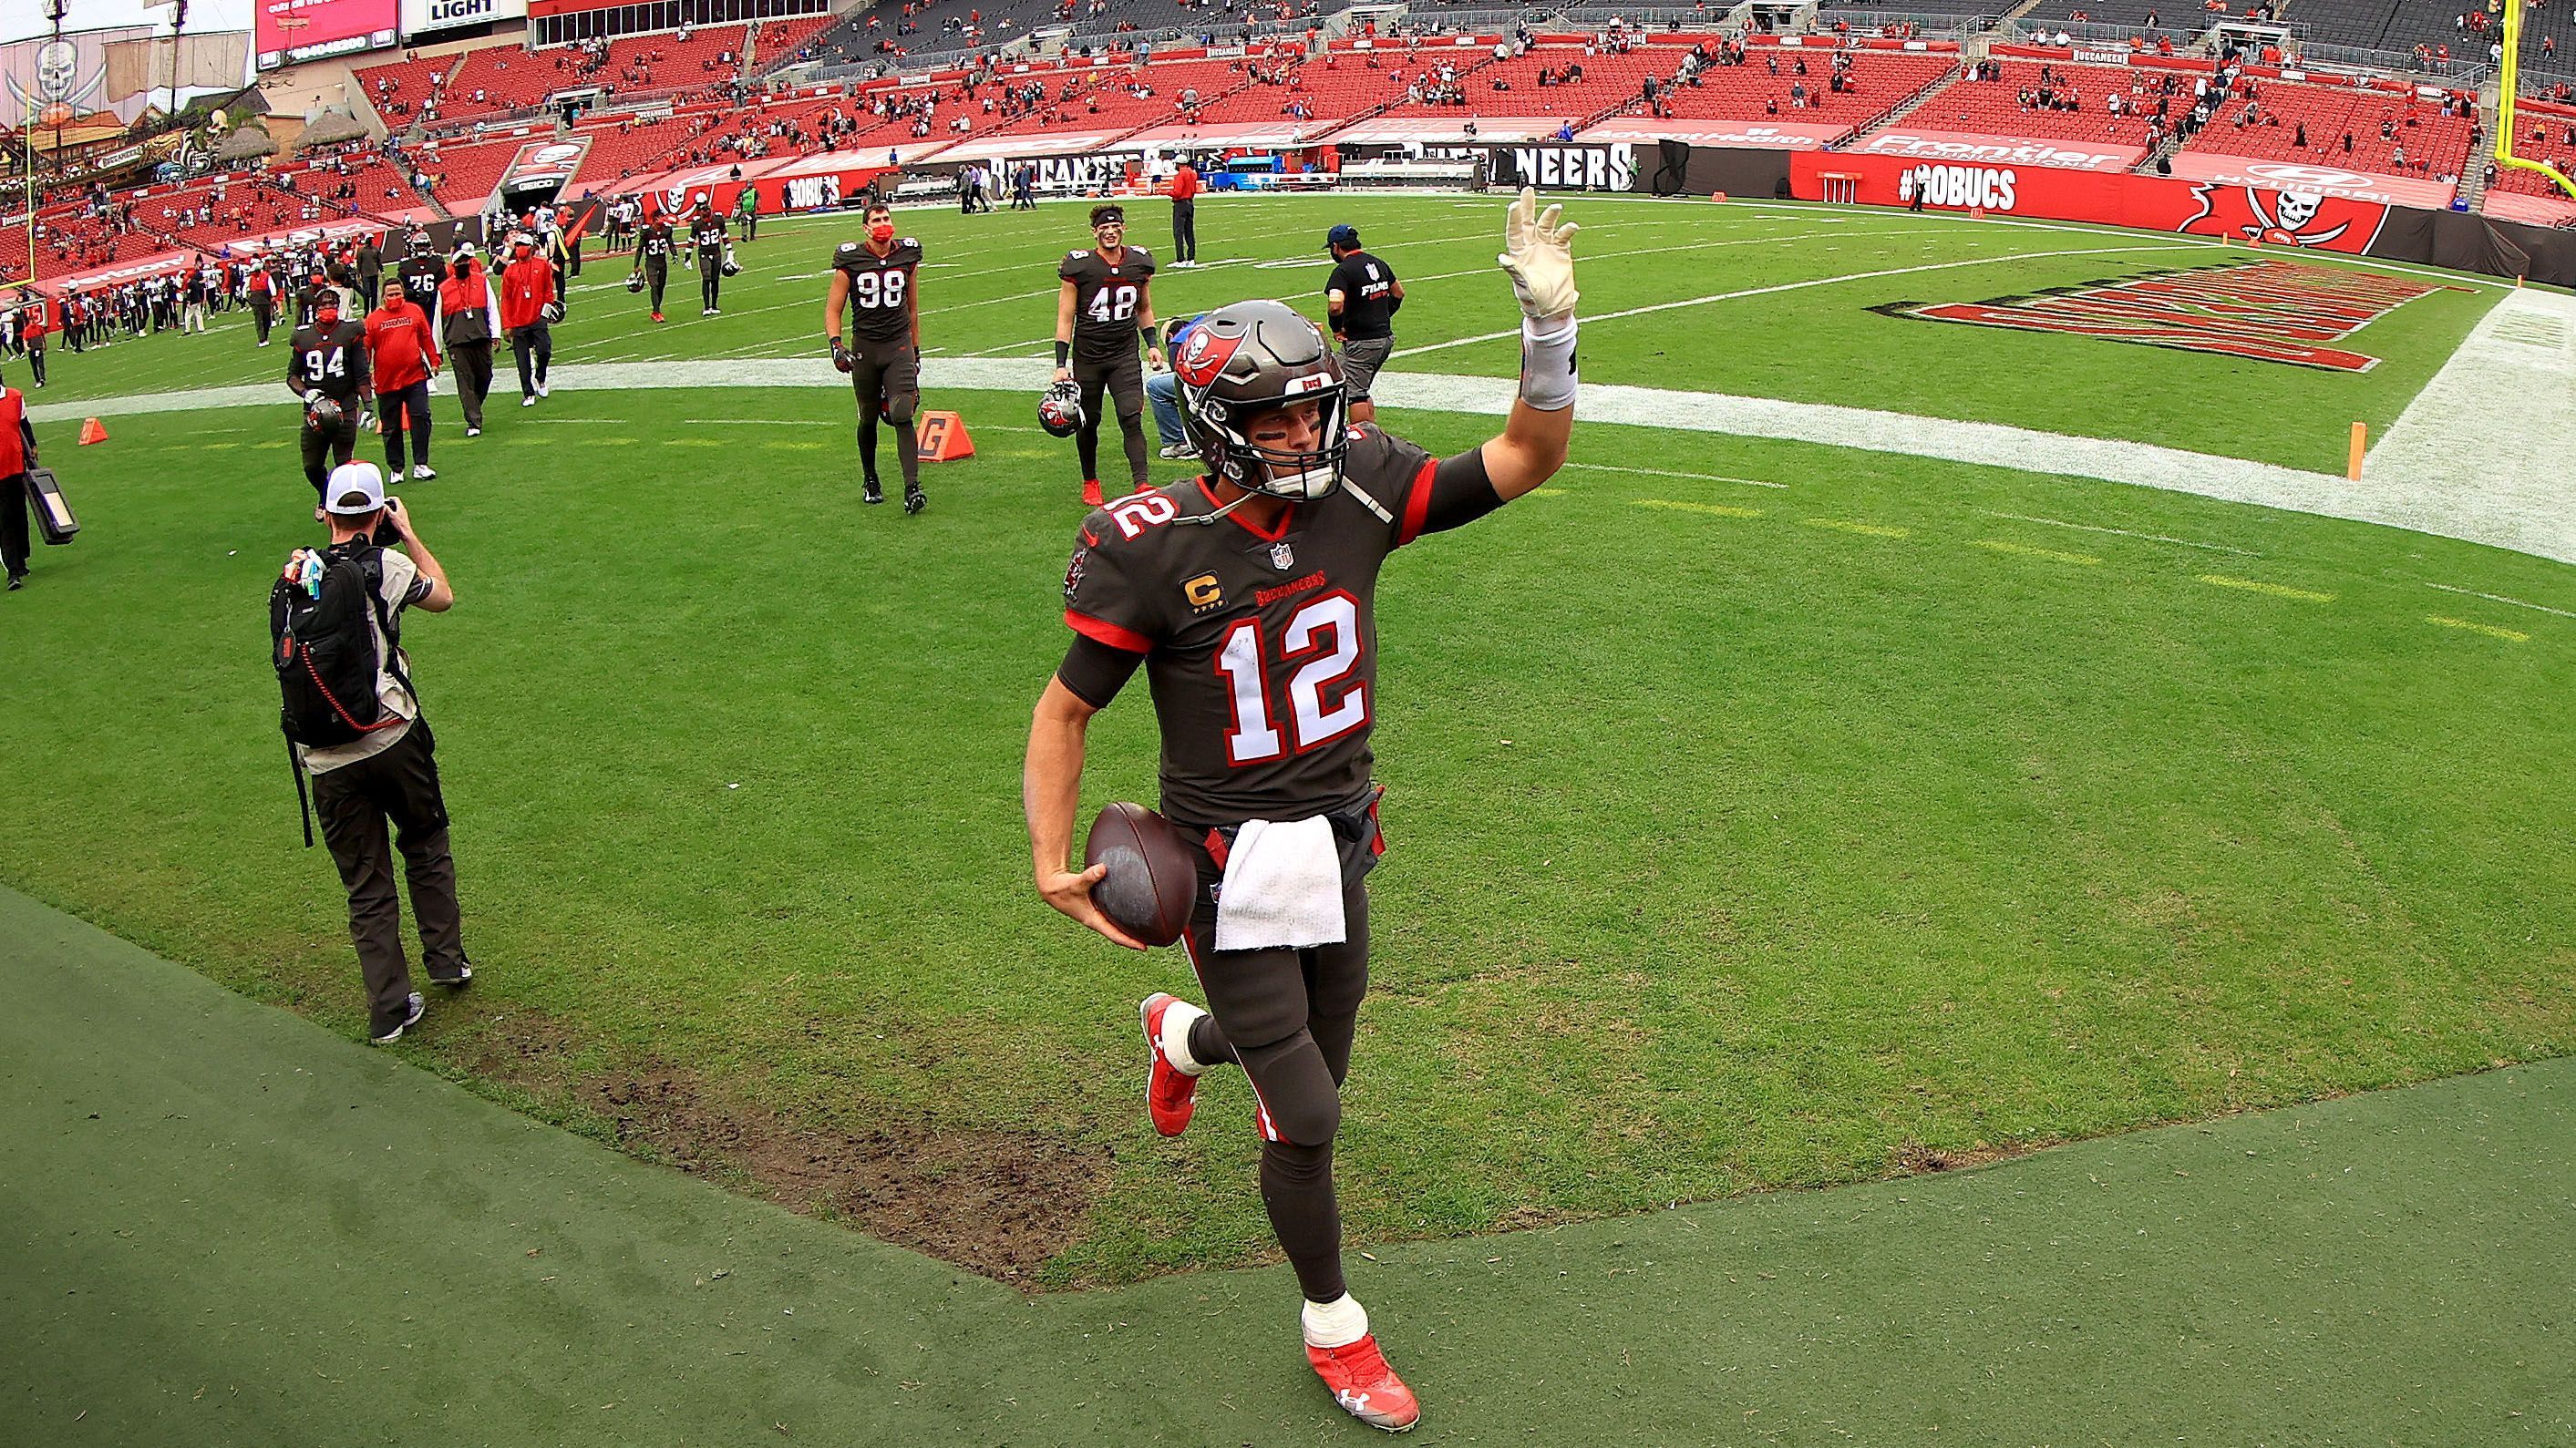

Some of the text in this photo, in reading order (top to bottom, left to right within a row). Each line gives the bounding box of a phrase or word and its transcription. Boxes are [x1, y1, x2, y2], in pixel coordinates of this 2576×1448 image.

[431, 0, 492, 21] LIGHT
[1869, 134, 2122, 164] Frontier
[518, 179, 554, 191] GEICO
[2214, 174, 2391, 203] HYUNDAI
[648, 239, 668, 255] 33
[700, 229, 719, 246] 32
[410, 274, 435, 292] 76
[857, 270, 905, 308] 98
[1361, 281, 1389, 296] FILMS
[1088, 286, 1138, 323] 48
[306, 346, 345, 381] 94
[921, 417, 946, 457] G
[1184, 575, 1220, 606] C
[1214, 589, 1370, 767] 12
